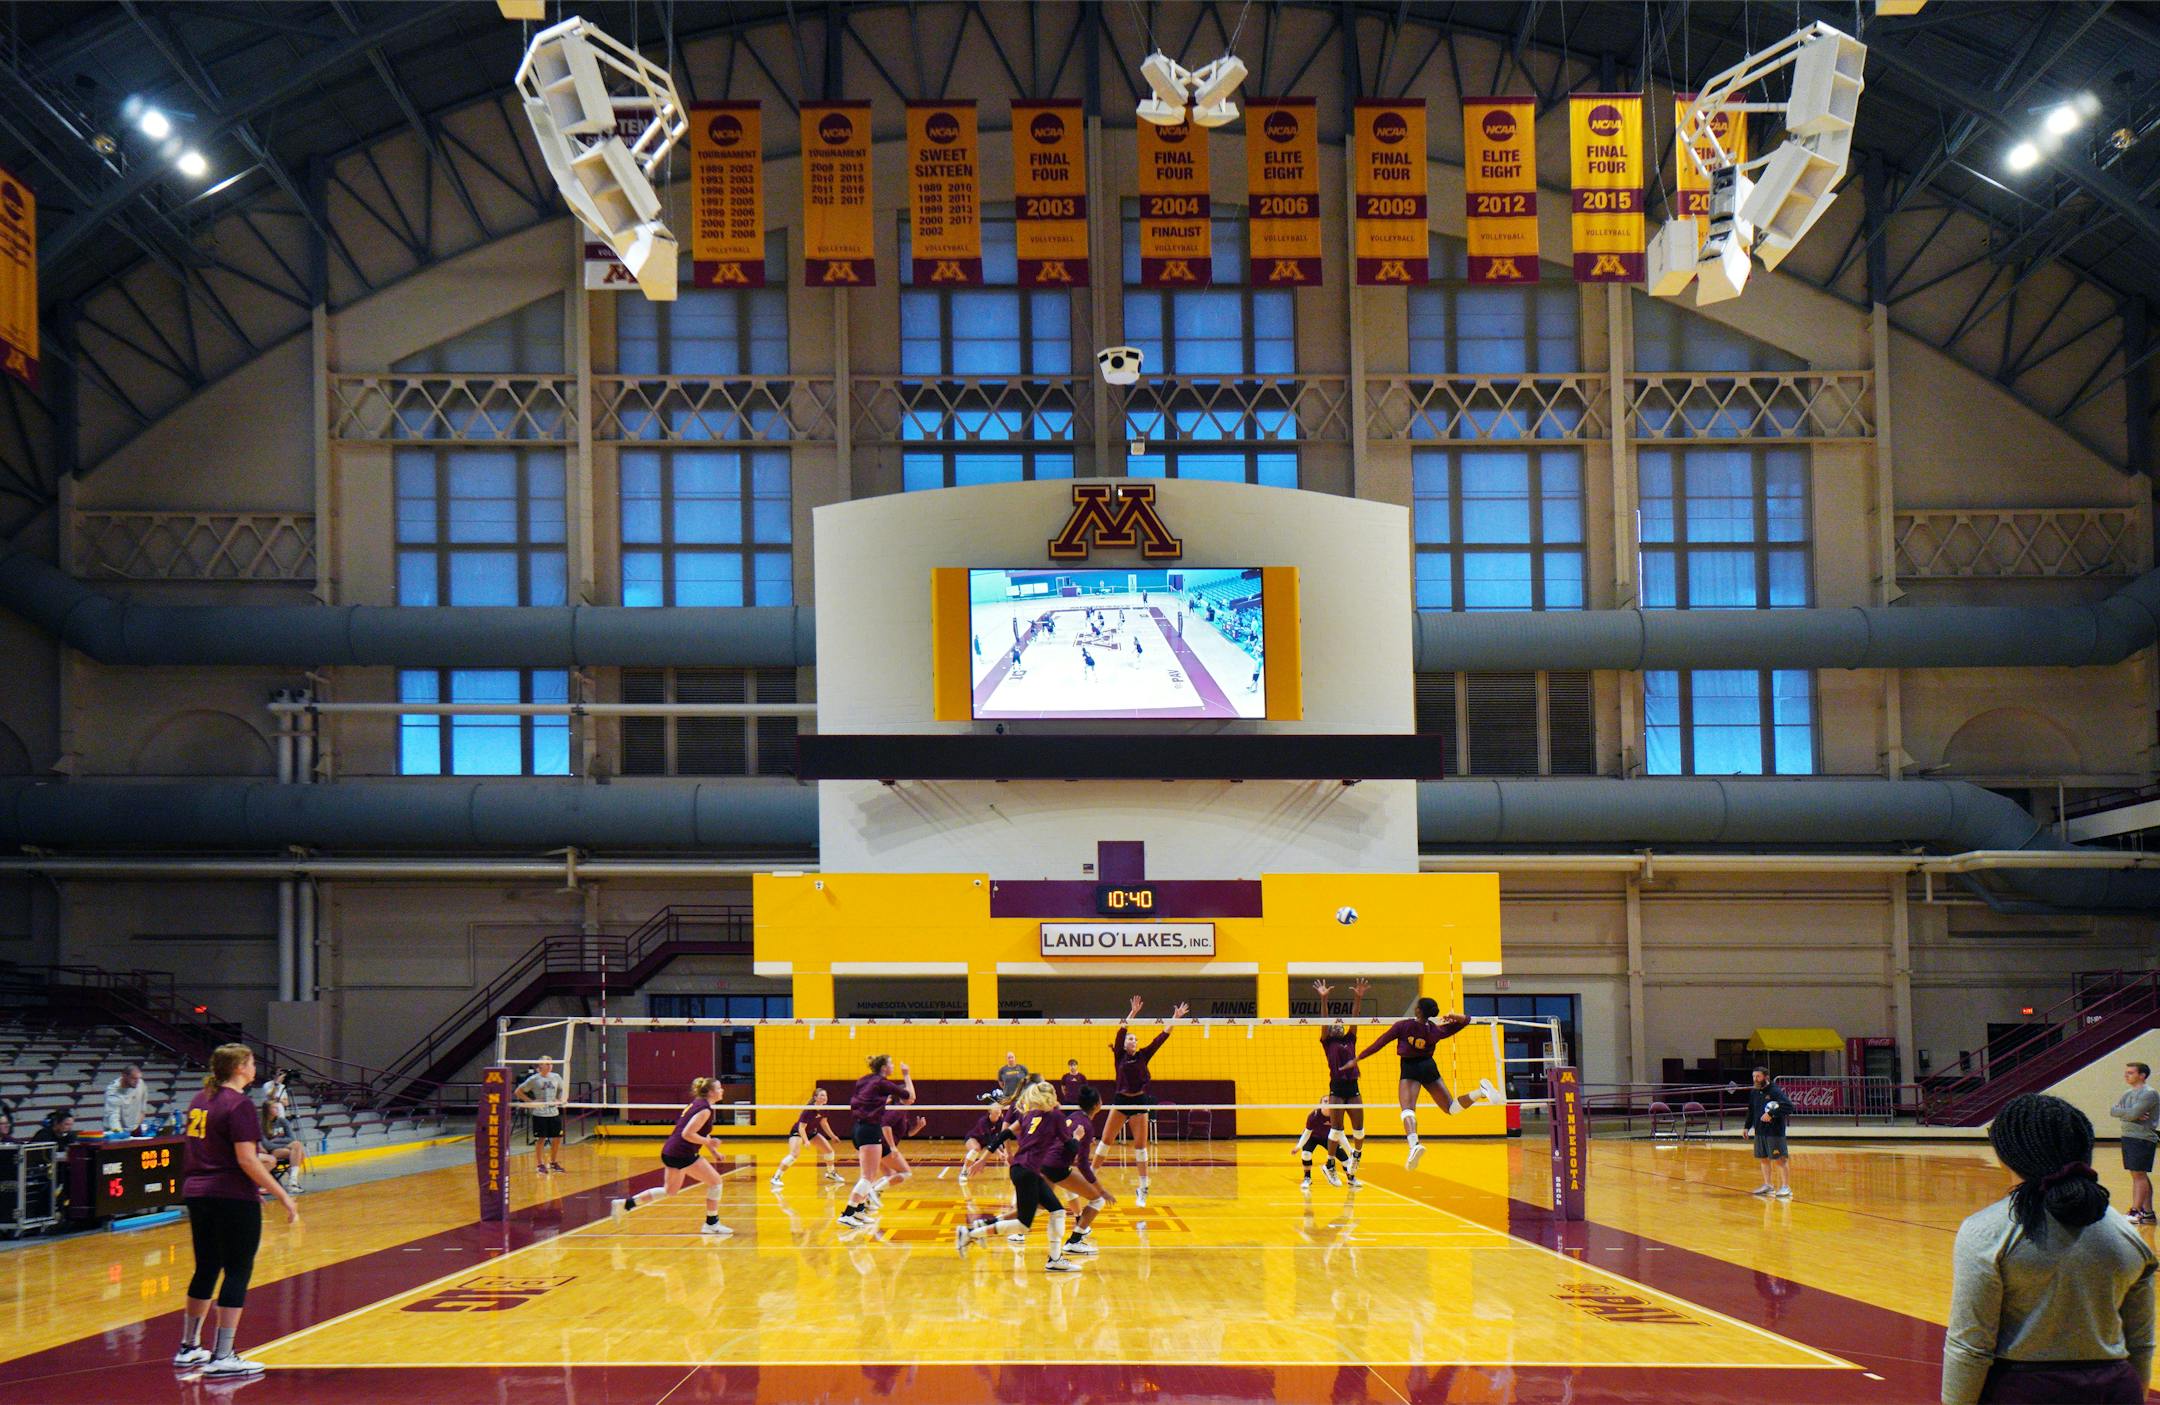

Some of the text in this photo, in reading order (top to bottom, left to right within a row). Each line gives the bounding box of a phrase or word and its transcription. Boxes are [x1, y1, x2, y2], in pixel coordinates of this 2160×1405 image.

[1486, 125, 1516, 134] NCAA
[1591, 119, 1623, 129] NCAA
[1034, 128, 1064, 137] NCAA
[1159, 126, 1189, 136] NCAA
[1267, 126, 1297, 135] NCAA
[1376, 127, 1406, 136] NCAA
[698, 151, 756, 160] TOURNAMENT
[920, 149, 968, 161] SWEET
[1154, 152, 1195, 164] FINAL
[1264, 151, 1302, 164] ELITE
[1483, 150, 1520, 162] ELITE
[1587, 146, 1627, 158] FINAL
[1030, 153, 1070, 165] FINAL
[1371, 152, 1412, 165] FINAL
[915, 164, 973, 177] SIXTEEN
[1481, 165, 1522, 178] EIGHT
[1589, 161, 1626, 173] FOUR
[1032, 168, 1069, 181] FOUR
[1156, 167, 1193, 180] FOUR
[1264, 167, 1304, 180] EIGHT
[1373, 168, 1410, 180] FOUR
[918, 184, 972, 193] 1989 2010
[919, 194, 972, 203] 1993 2011
[1477, 196, 1526, 213] 2012
[1583, 191, 1631, 209] 2015
[920, 205, 972, 214] 1999 2013
[1027, 199, 1074, 217] 2003
[1151, 198, 1199, 215] 2004
[1260, 198, 1308, 215] 2006
[1367, 198, 1416, 215] 2009
[920, 216, 972, 225] 2000 2017
[920, 227, 943, 236] 2002
[1151, 227, 1202, 237] FINALIST
[1048, 483, 1183, 560] M
[1108, 891, 1152, 908] 10:40
[1044, 933, 1094, 947] LAND
[1189, 938, 1212, 947] INC.
[998, 1001, 1032, 1009] YMPICS
[1211, 1001, 1361, 1015] MINNE VOLLYBAL
[187, 1108, 208, 1139] 21
[1028, 1117, 1042, 1135] 7
[488, 1093, 500, 1190] MINNESOTA
[1565, 1092, 1578, 1190] MINNESOTA
